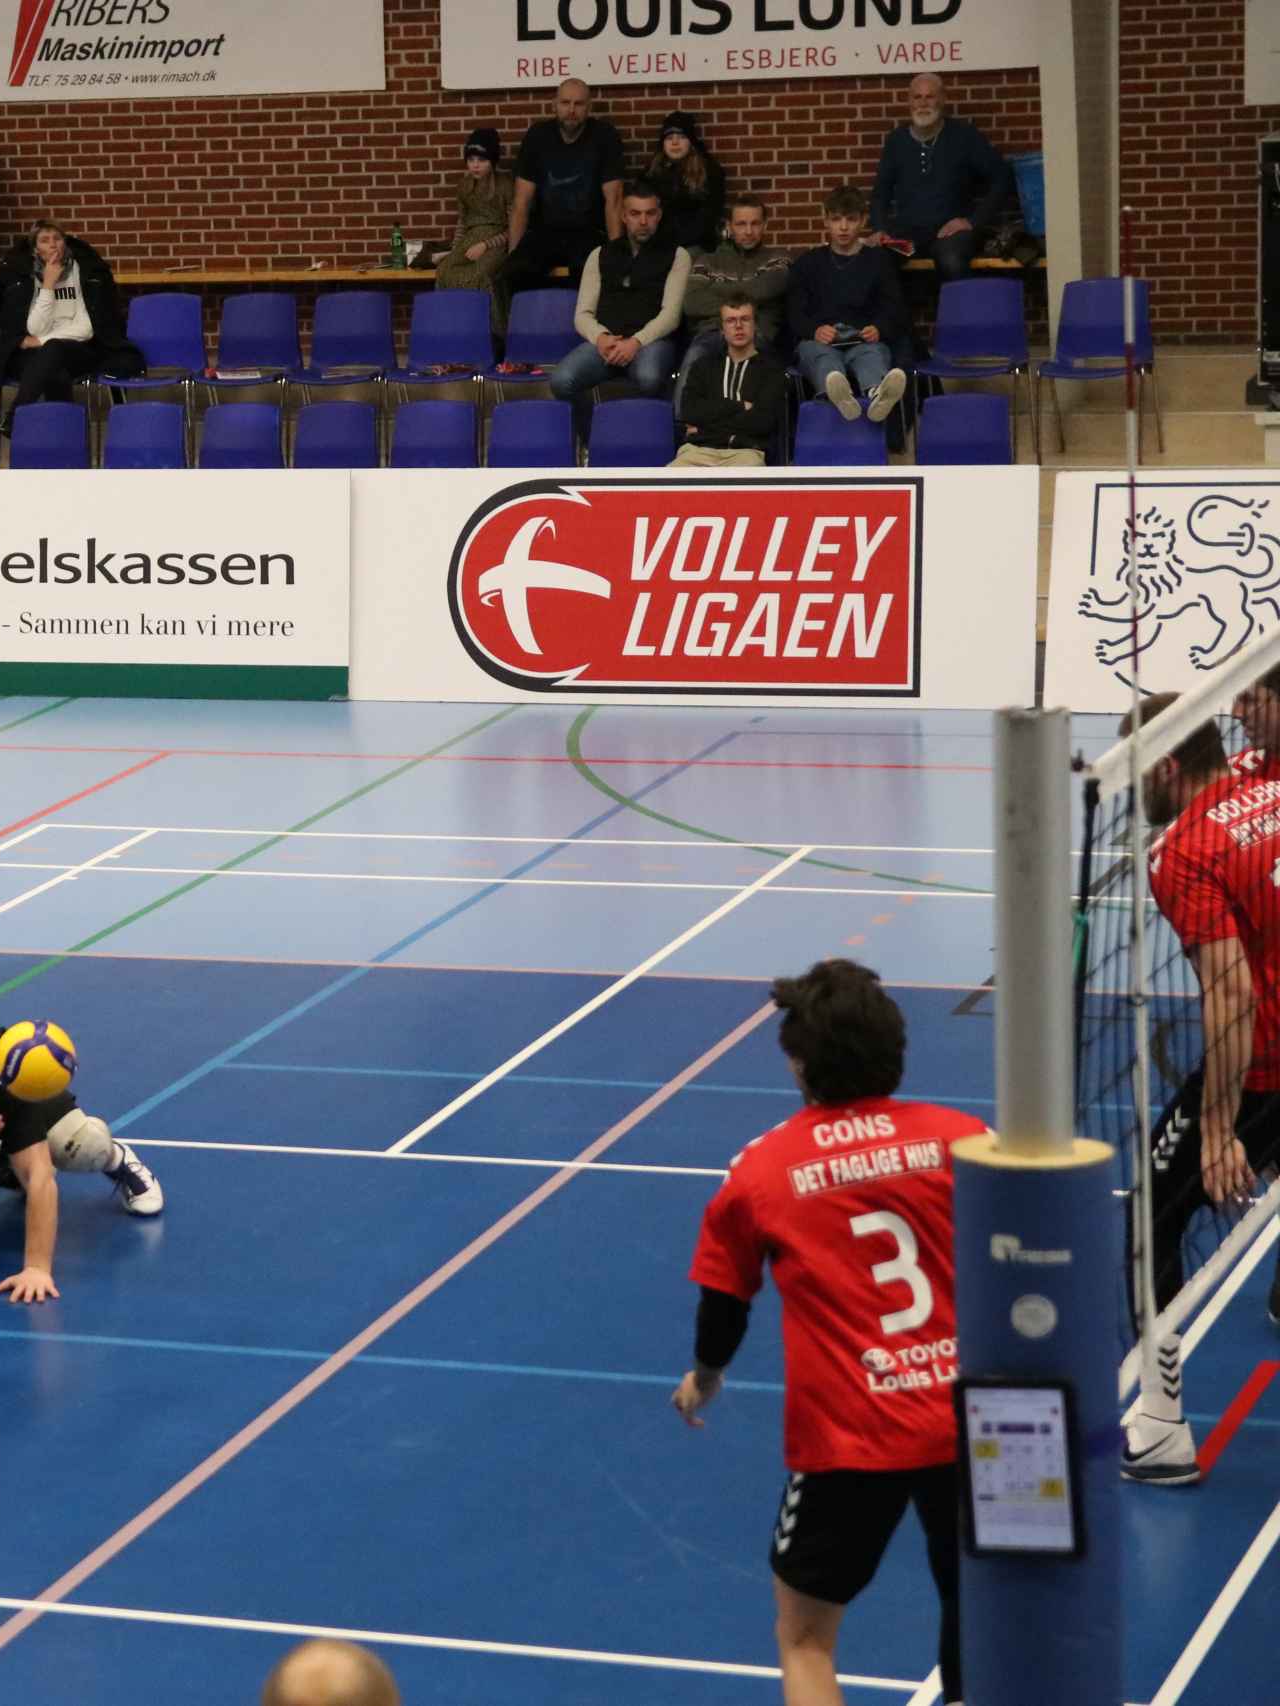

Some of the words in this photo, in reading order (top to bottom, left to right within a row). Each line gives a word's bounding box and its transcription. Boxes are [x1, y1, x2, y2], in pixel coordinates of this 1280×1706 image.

[50, 0, 170, 26] RIBERS
[517, 0, 732, 41] LOUIS
[754, 0, 961, 32] LUND
[37, 34, 225, 64] Maskinimport
[517, 56, 571, 77] RIBE
[608, 53, 687, 74] VEJEN
[726, 46, 837, 70] ESBJERG
[877, 41, 963, 65] VARDE
[55, 74, 70, 86] 75
[70, 73, 87, 86] 29
[88, 73, 104, 85] 84
[105, 72, 121, 84] 58
[630, 516, 898, 581] VOLLEY
[18, 612, 130, 636] Sammen
[140, 613, 186, 636] kan
[196, 614, 218, 636] vi
[228, 617, 295, 637] mere
[622, 592, 894, 658] LIGAEN
[813, 1114, 896, 1148] CONS
[792, 1162, 827, 1195] DET
[829, 1147, 902, 1184] FAGLIGE
[904, 1141, 942, 1168] HUS
[849, 1210, 934, 1335] 3
[896, 1338, 957, 1366] TOYO
[867, 1369, 931, 1391] Louis
